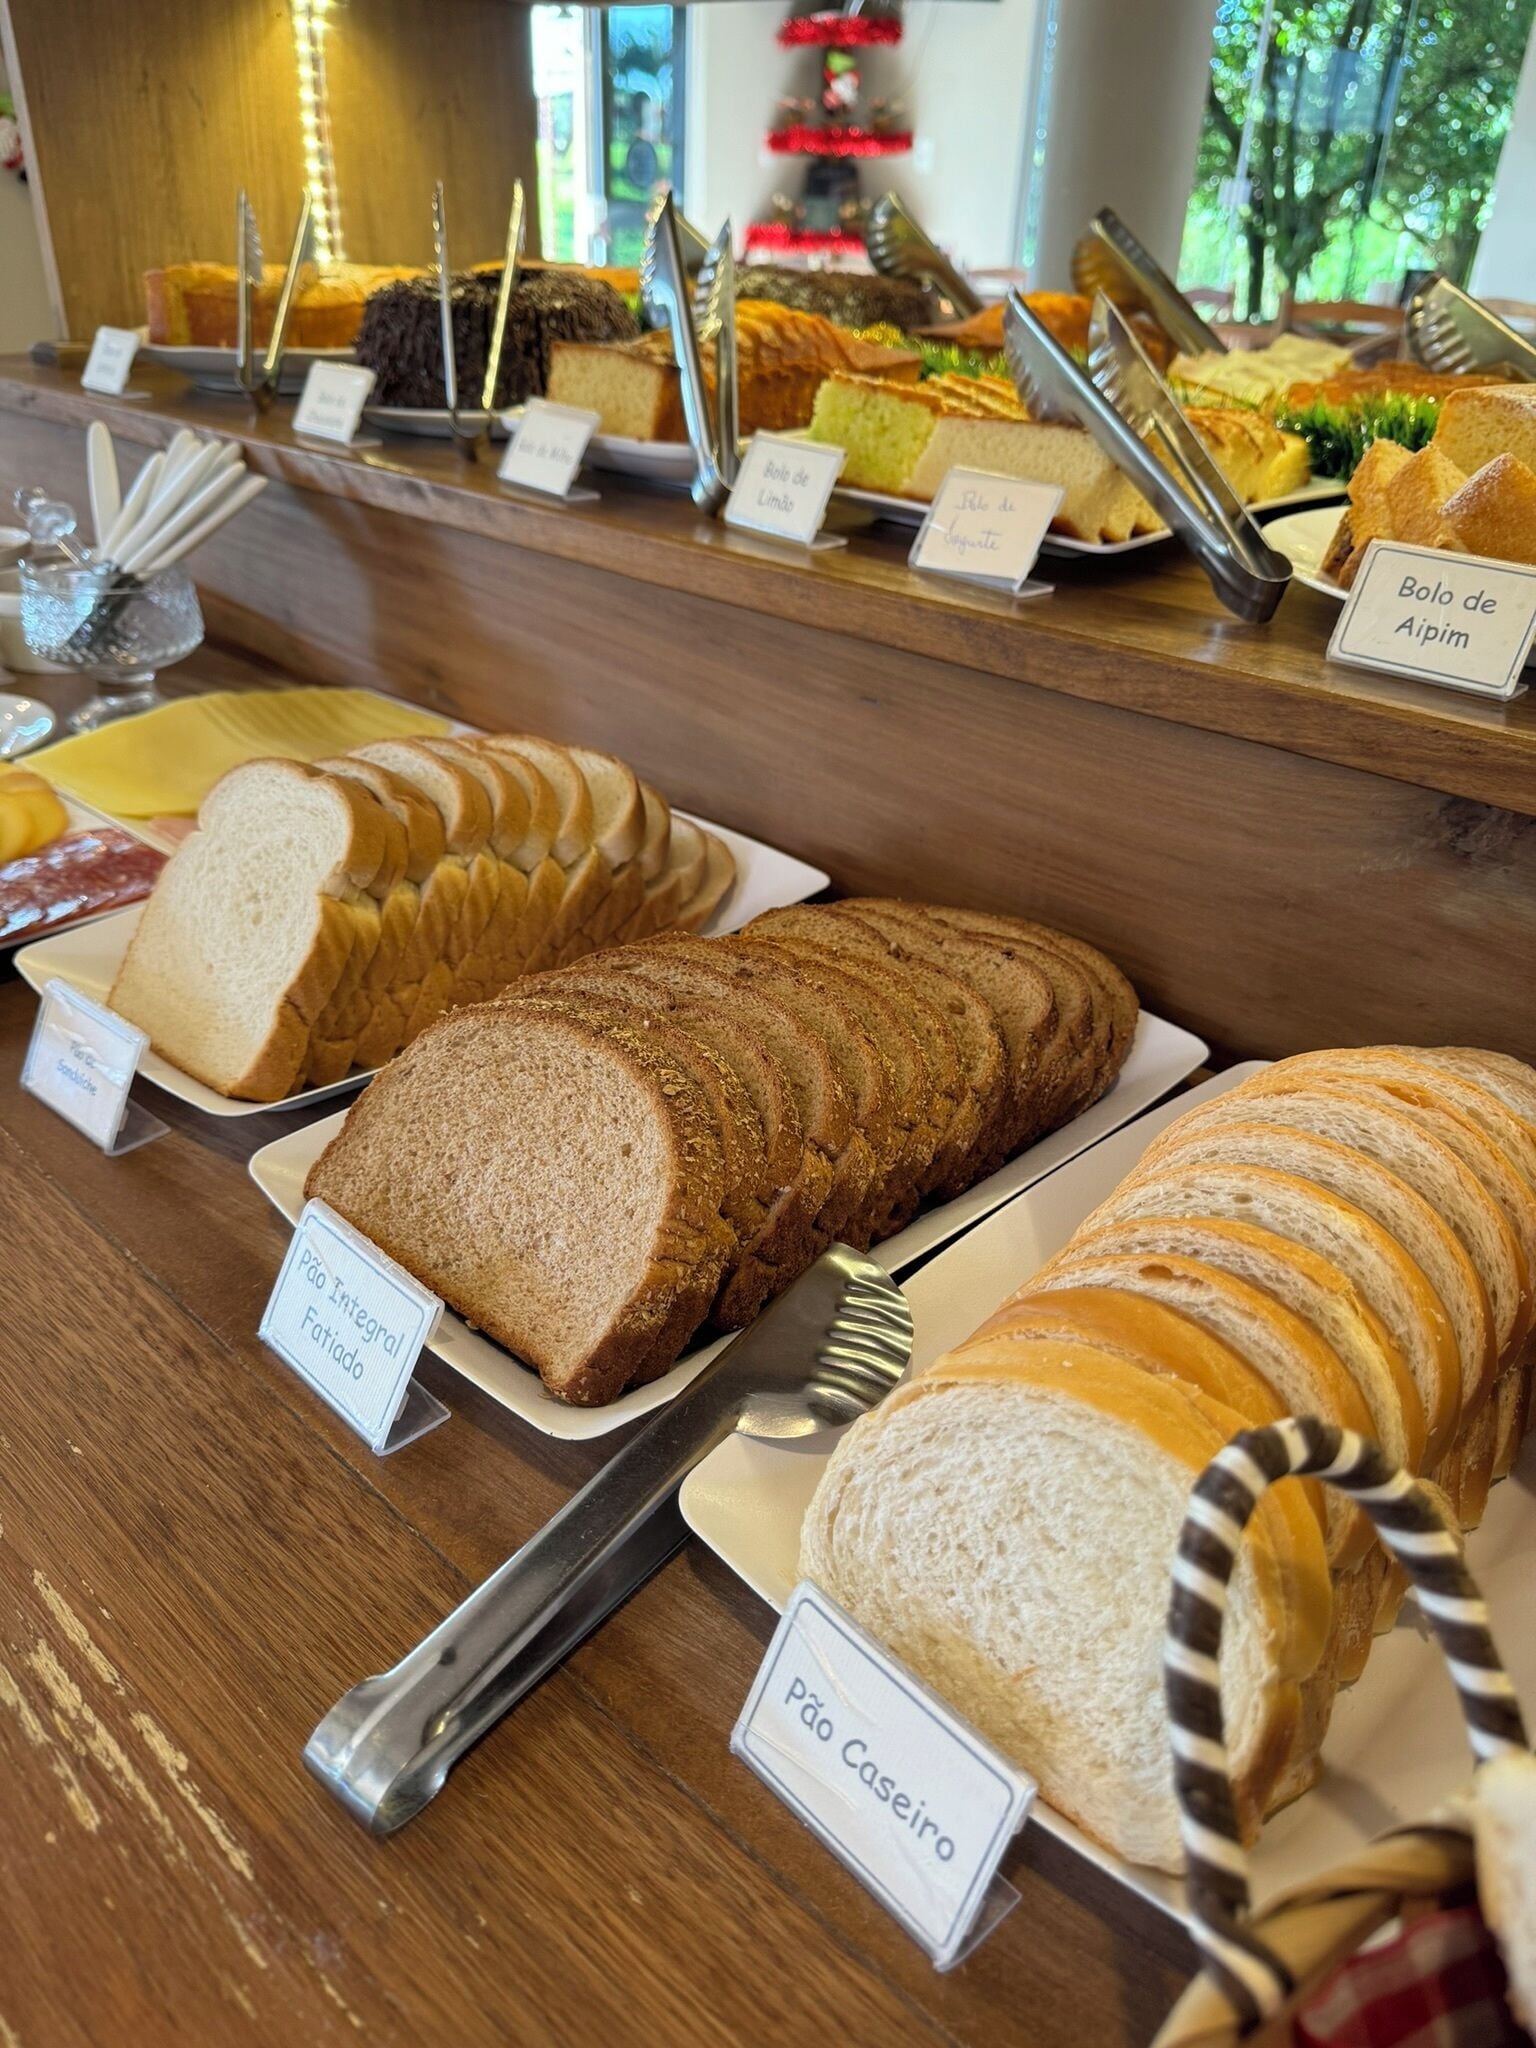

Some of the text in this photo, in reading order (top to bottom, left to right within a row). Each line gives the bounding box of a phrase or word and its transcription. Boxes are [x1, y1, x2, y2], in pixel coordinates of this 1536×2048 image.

[757, 489, 794, 513] Limão
[1398, 576, 1497, 614] Bolo de
[1394, 616, 1470, 648] Aipim
[298, 1249, 404, 1358] Pão Integral
[300, 1306, 364, 1380] Fatiado
[784, 1677, 955, 1862] Pão Caseiro
